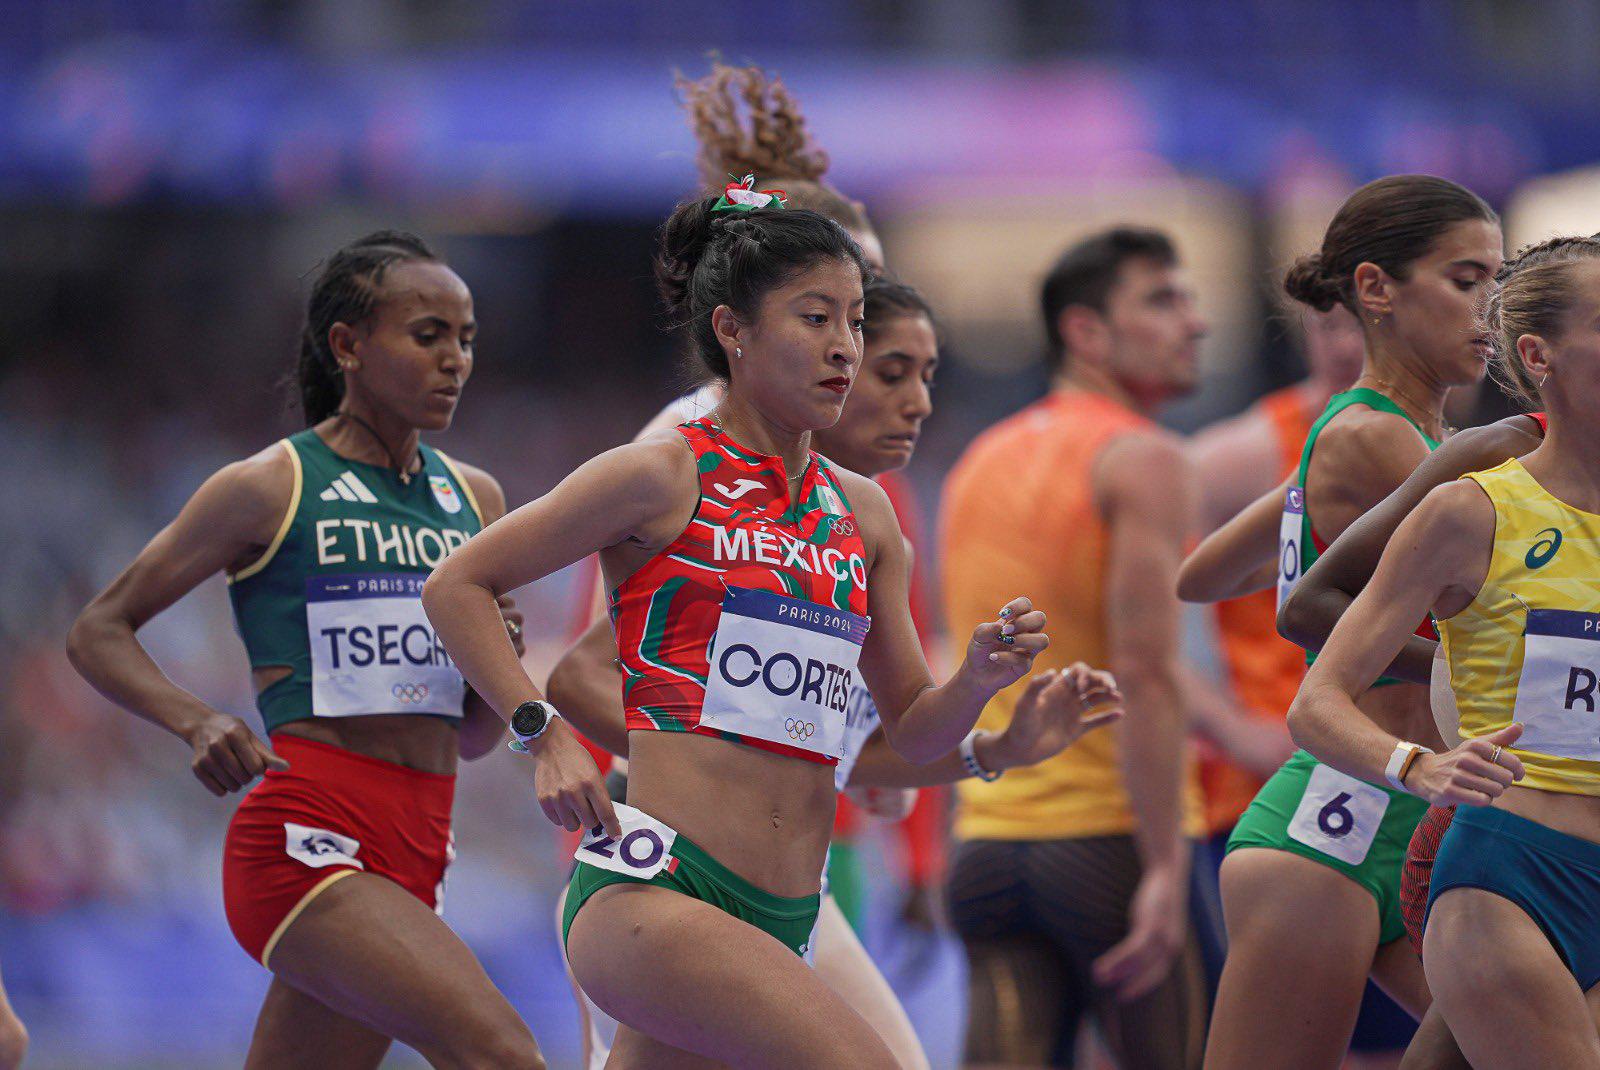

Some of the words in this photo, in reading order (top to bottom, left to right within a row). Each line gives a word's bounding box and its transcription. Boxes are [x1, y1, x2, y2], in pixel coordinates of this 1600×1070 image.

[316, 518, 471, 569] ETHIOP
[713, 526, 867, 592] MÉXICO
[320, 624, 450, 669] TSEGA
[718, 643, 852, 714] CORTES
[1564, 666, 1600, 713] R
[1317, 791, 1354, 839] 6
[582, 822, 664, 869] 20
